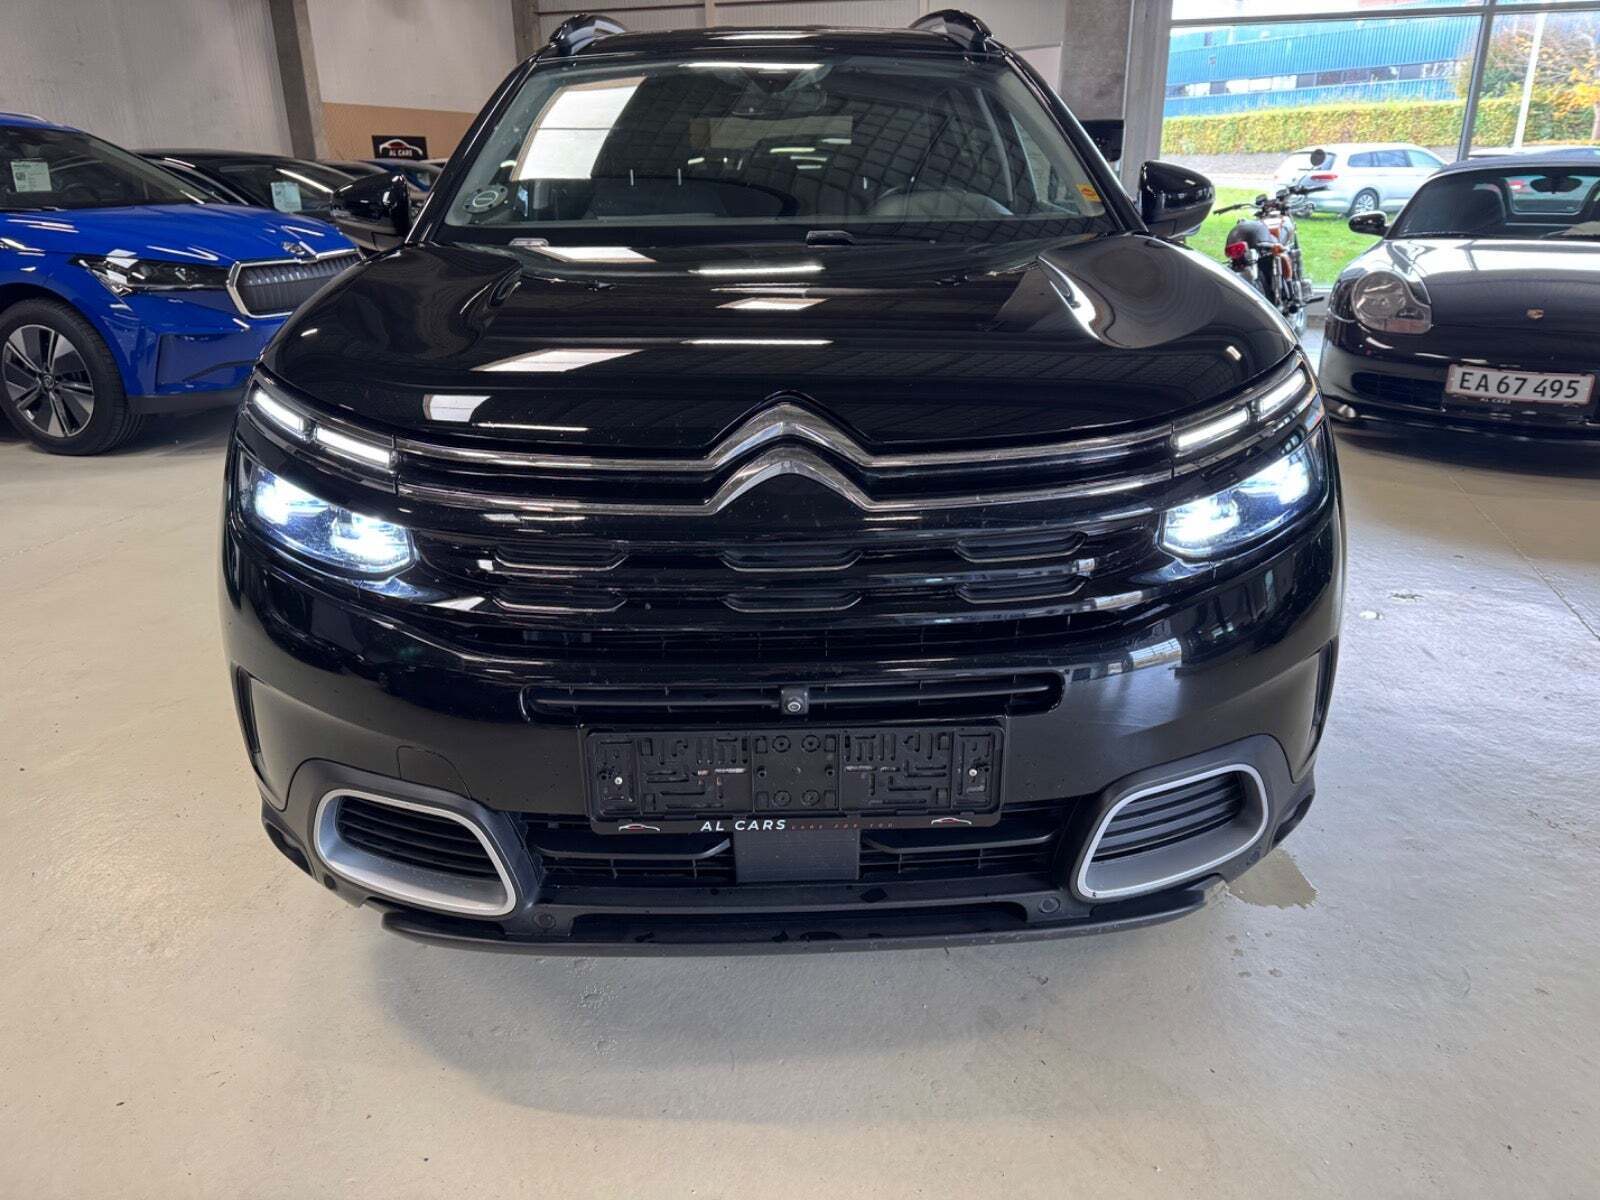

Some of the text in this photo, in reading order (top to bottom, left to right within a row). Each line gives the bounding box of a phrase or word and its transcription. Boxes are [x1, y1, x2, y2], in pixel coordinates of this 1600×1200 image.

[1459, 371, 1581, 399] EA 67 495
[700, 820, 725, 832] AL
[734, 819, 787, 831] CARS
